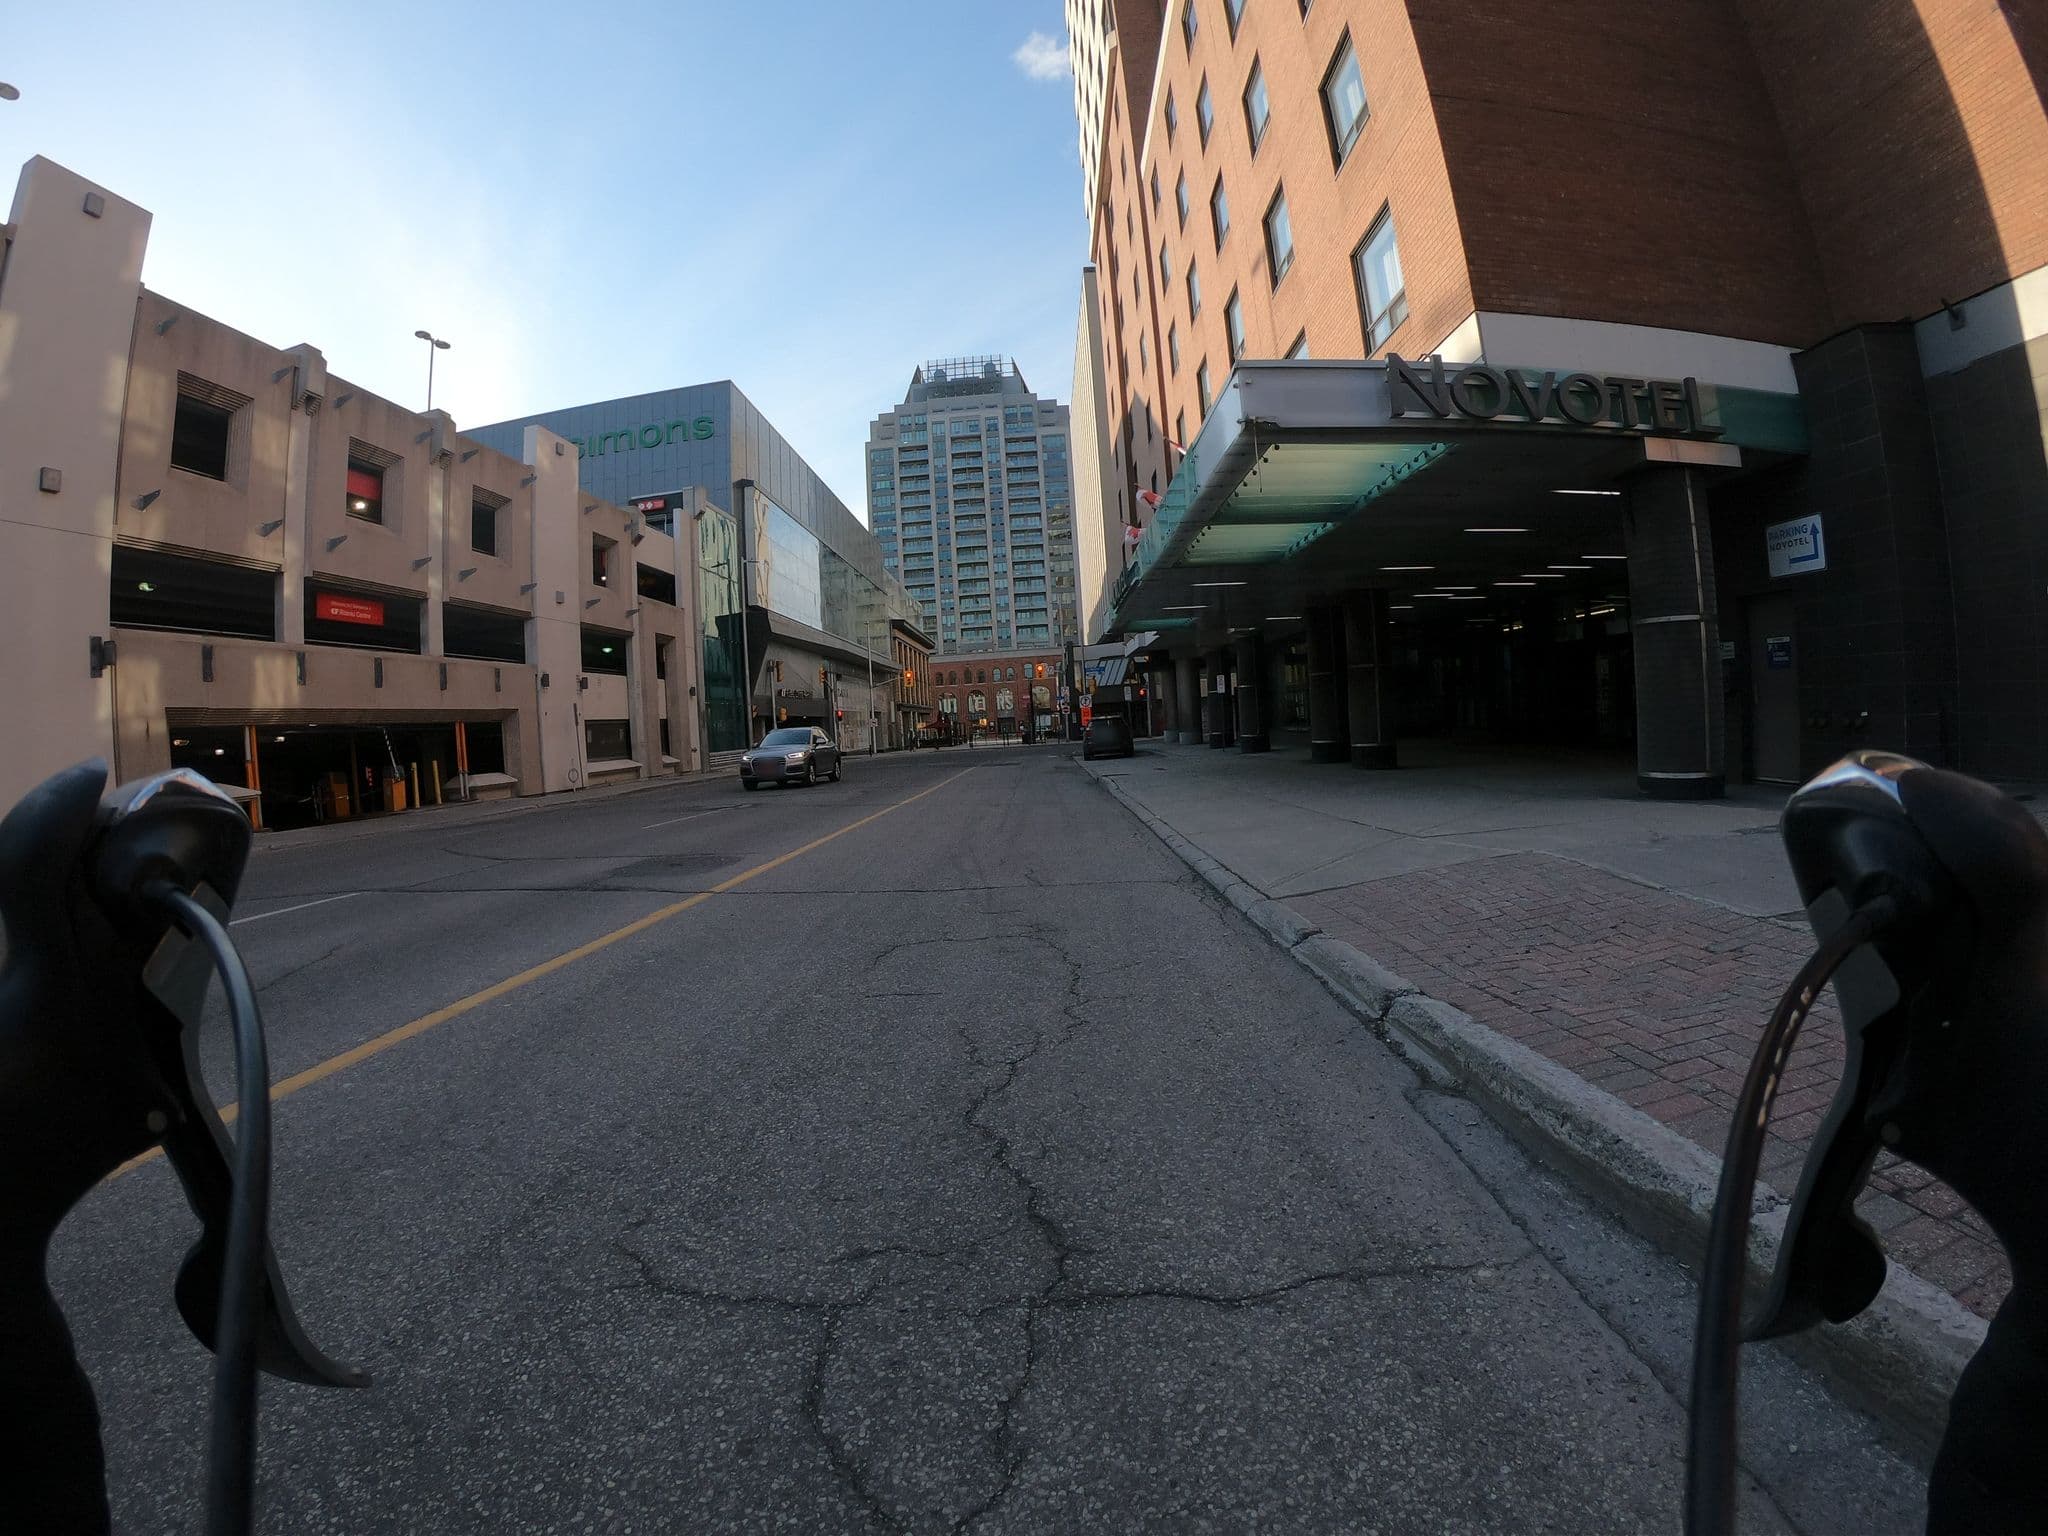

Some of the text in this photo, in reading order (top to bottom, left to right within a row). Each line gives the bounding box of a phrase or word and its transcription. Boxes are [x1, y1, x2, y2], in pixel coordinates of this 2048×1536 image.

[1385, 352, 1726, 436] NOVOTEL
[1768, 524, 1808, 541] PARKING
[1770, 537, 1810, 552] NOVOTEL
